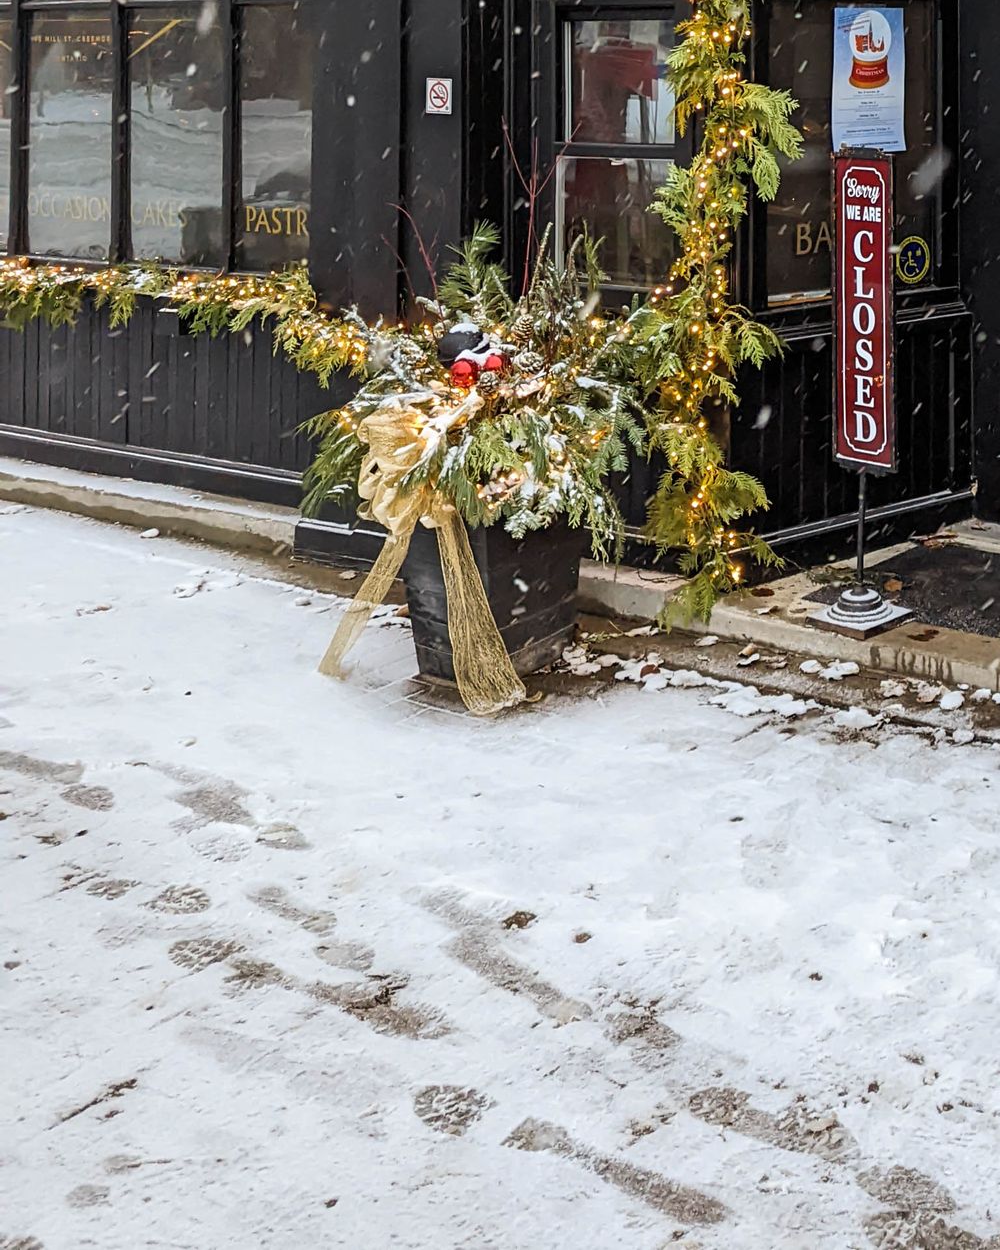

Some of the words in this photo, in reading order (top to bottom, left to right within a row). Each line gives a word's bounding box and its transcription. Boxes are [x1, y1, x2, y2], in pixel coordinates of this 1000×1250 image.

[846, 178, 880, 204] Sorry
[846, 204, 861, 221] WE
[863, 206, 882, 223] ARE
[796, 221, 832, 255] BA
[852, 230, 878, 443] CLOSED
